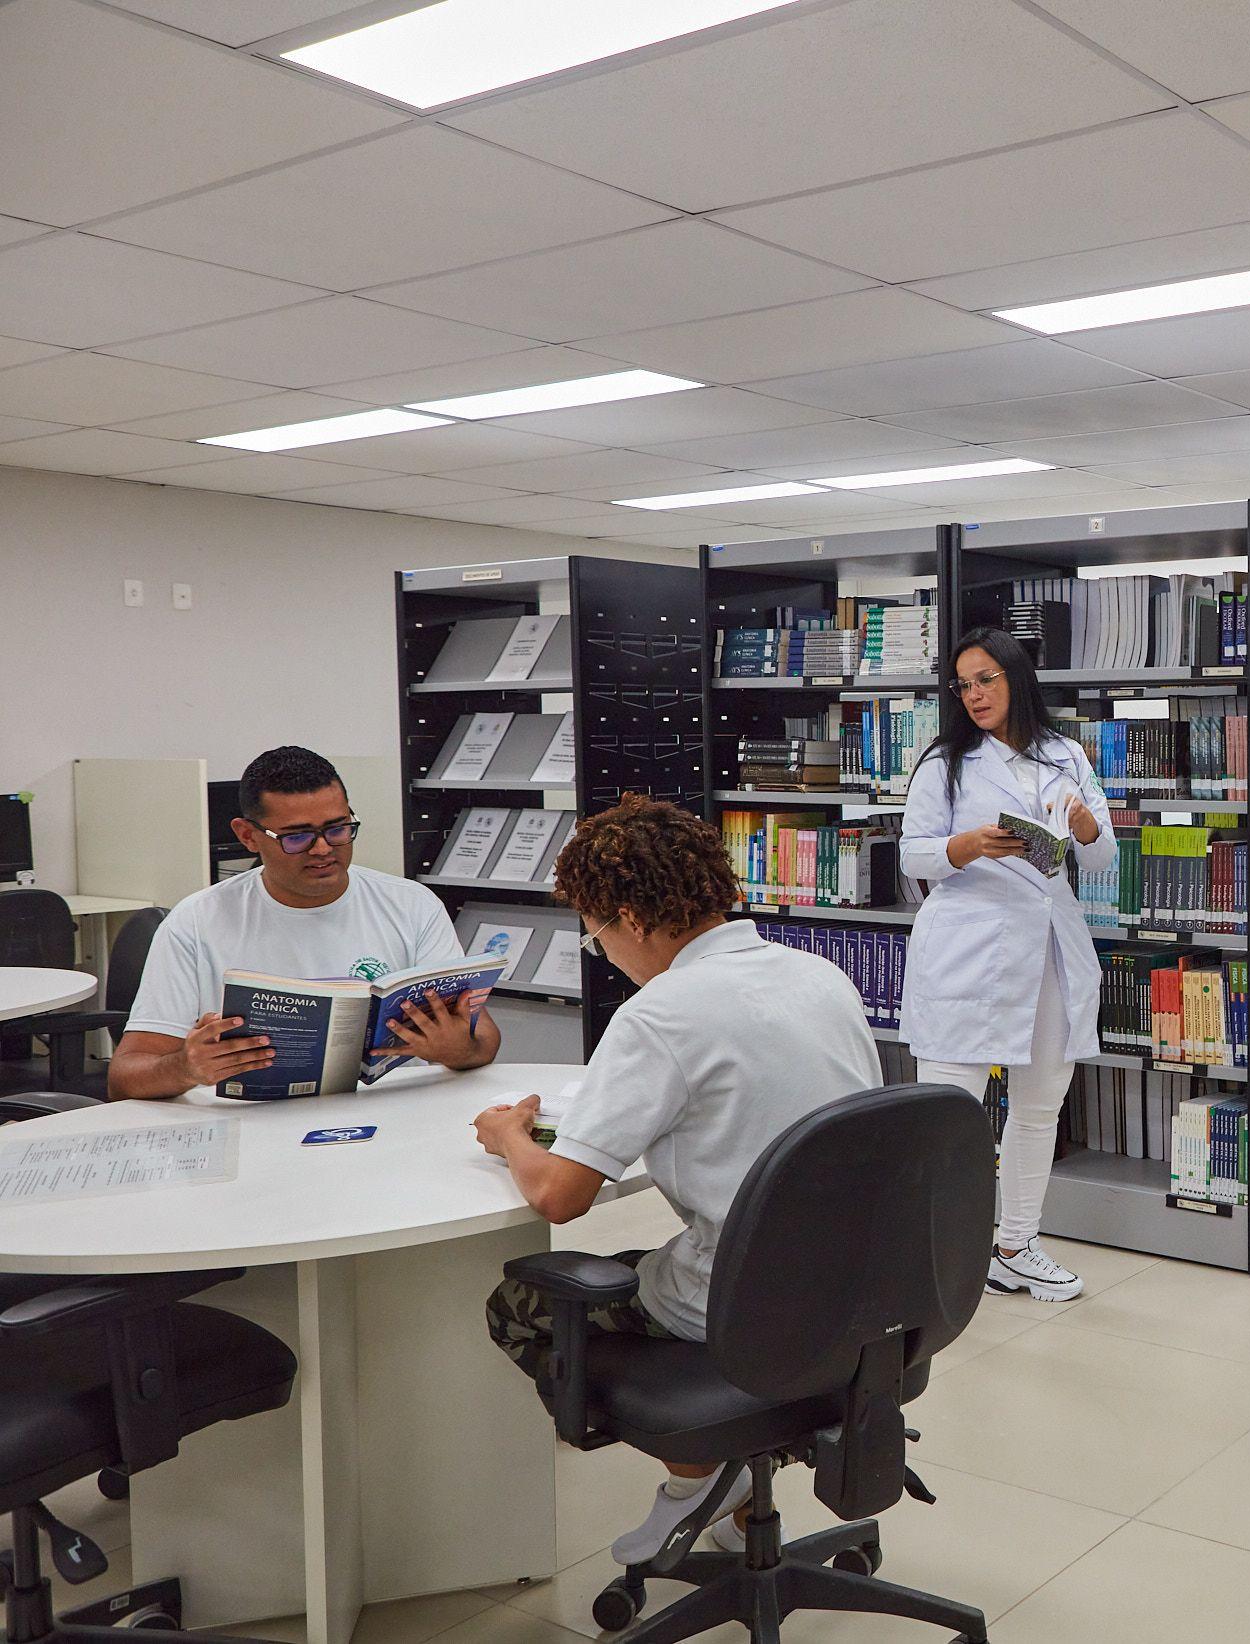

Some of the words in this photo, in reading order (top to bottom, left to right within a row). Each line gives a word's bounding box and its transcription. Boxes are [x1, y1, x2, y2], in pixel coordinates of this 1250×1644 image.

[408, 972, 480, 994] ANATOMIA
[406, 982, 457, 1000] CLICA
[252, 992, 318, 1006] ANATOMIA
[252, 1001, 298, 1014] CLÍNICA
[268, 1012, 307, 1020] ESTUDANTES
